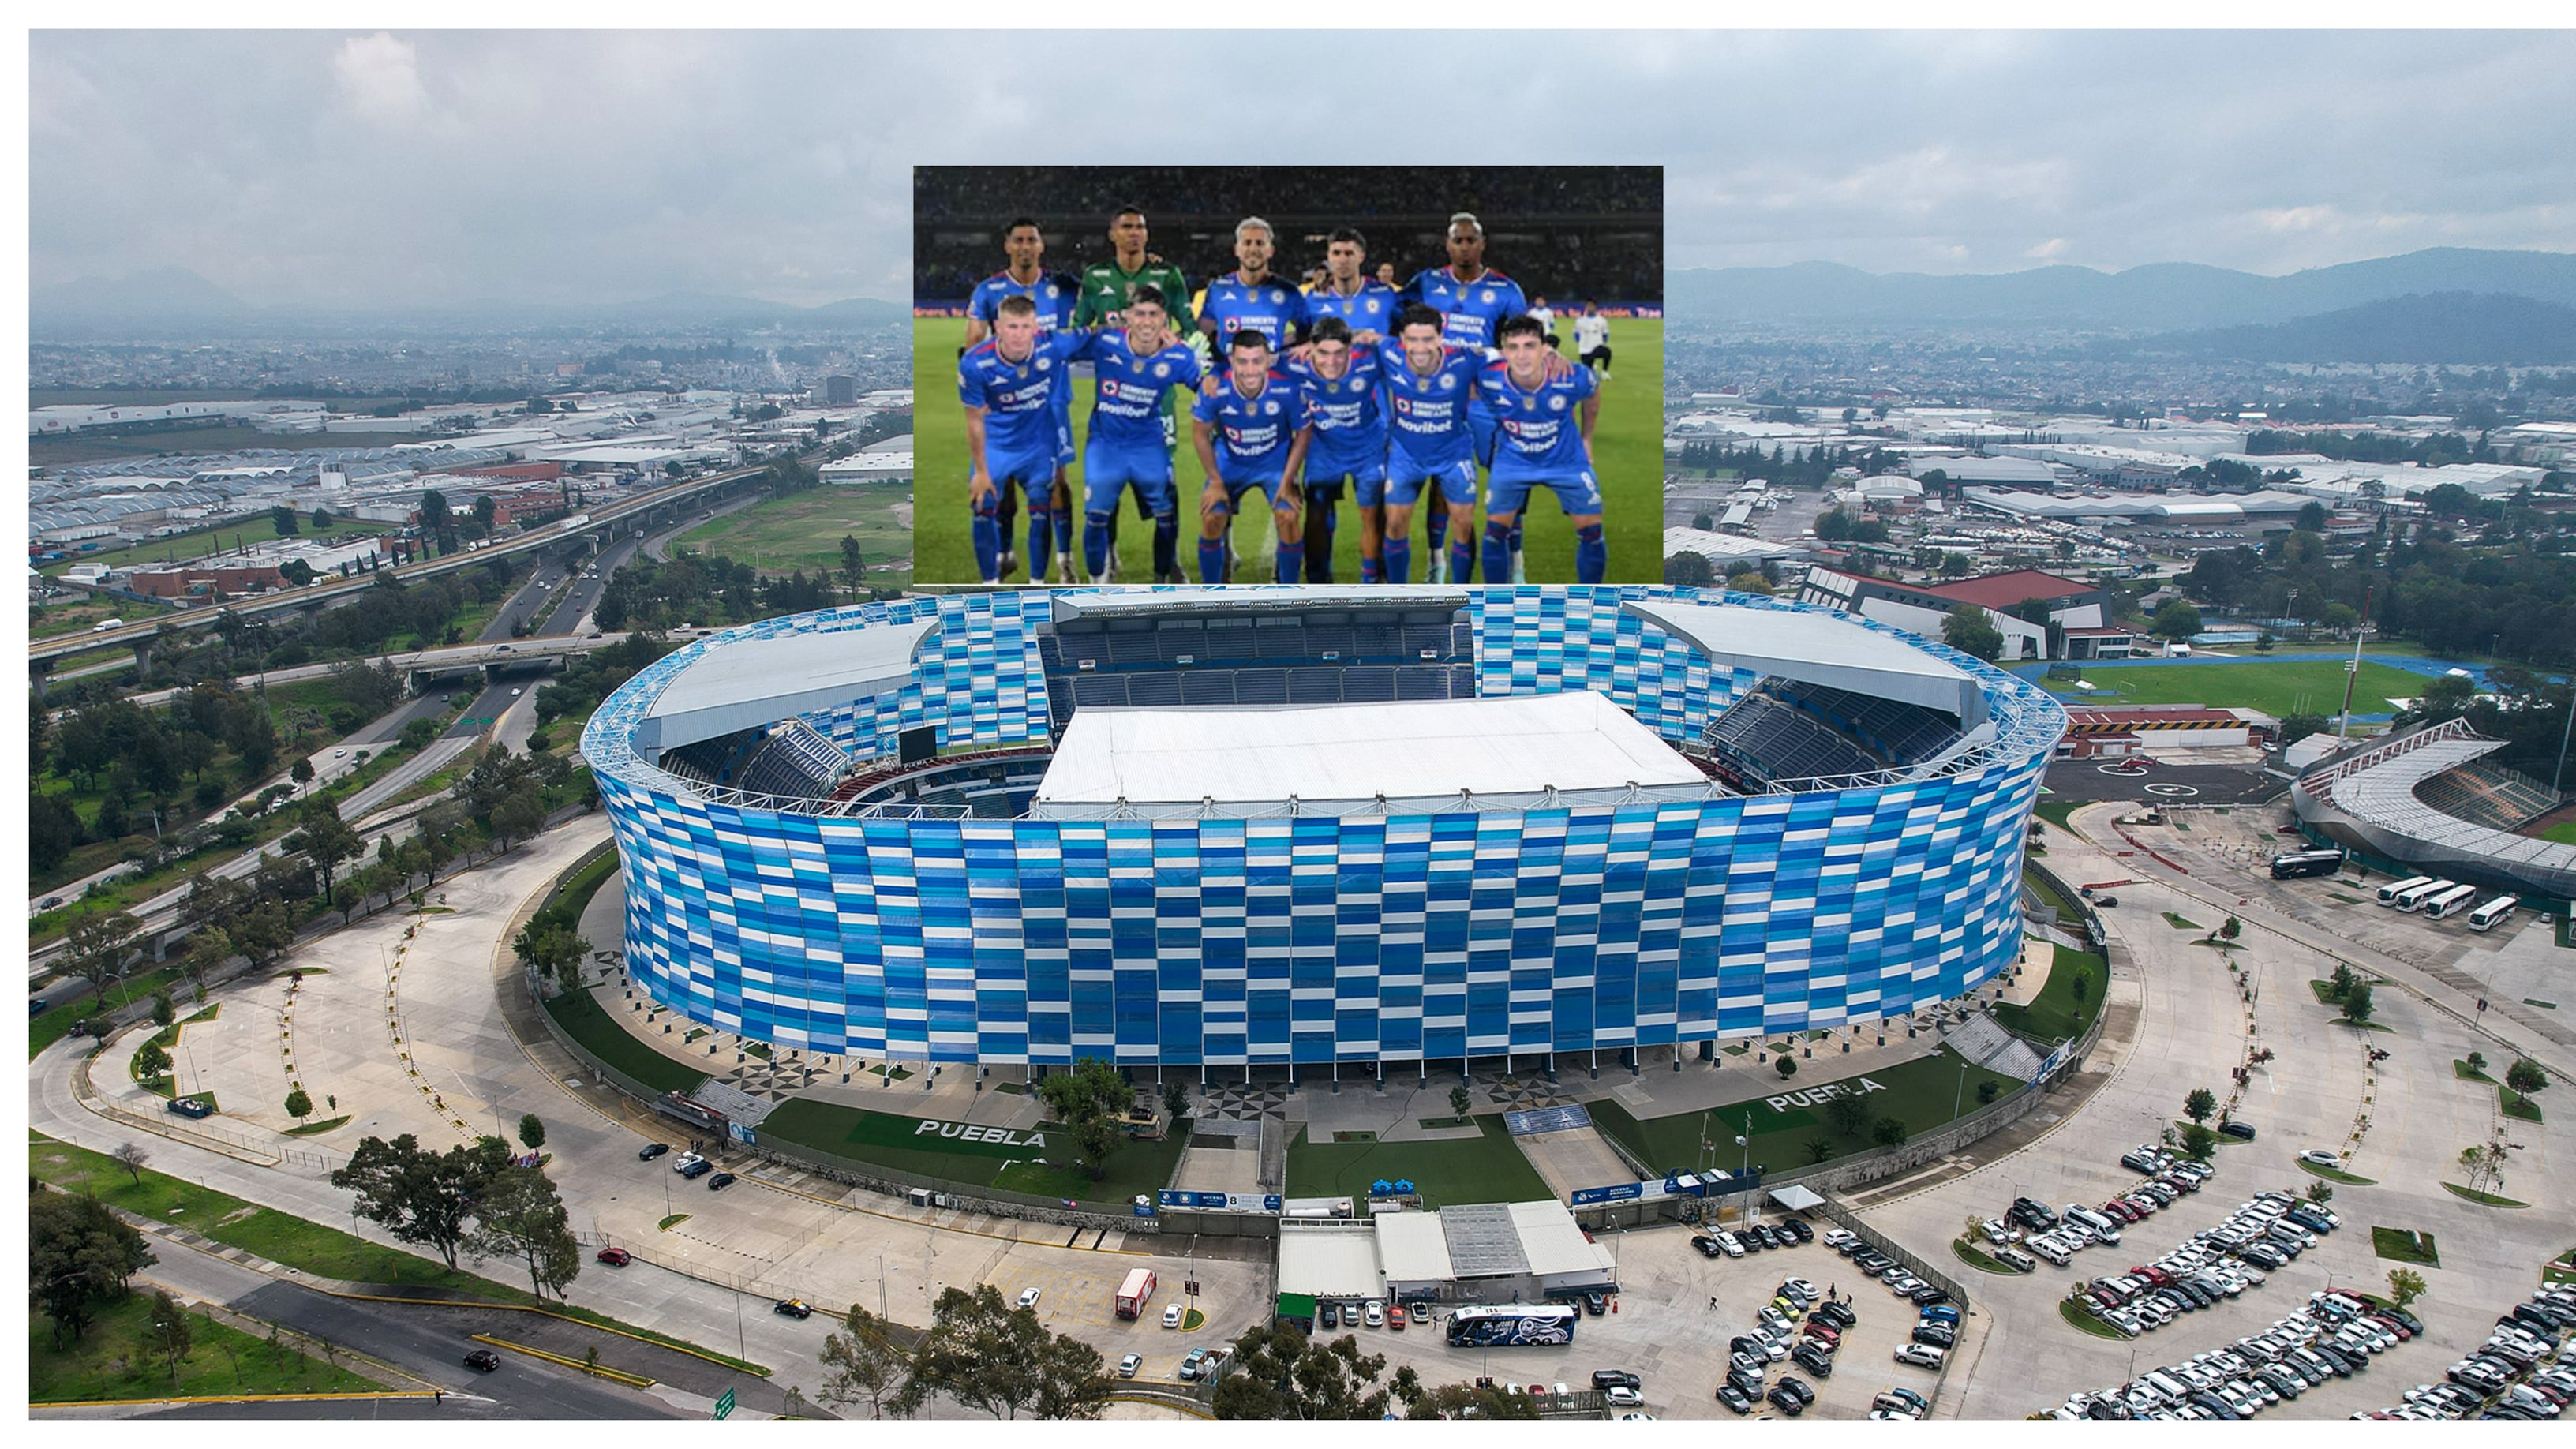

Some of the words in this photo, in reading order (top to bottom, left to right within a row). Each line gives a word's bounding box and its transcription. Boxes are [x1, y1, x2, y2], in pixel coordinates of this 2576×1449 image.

[1099, 401, 1151, 417] novibet
[1397, 416, 1452, 434] novibet
[1581, 471, 1595, 492] 8
[1766, 1077, 1887, 1113] PUEA
[915, 1120, 1046, 1148] PUEBLA
